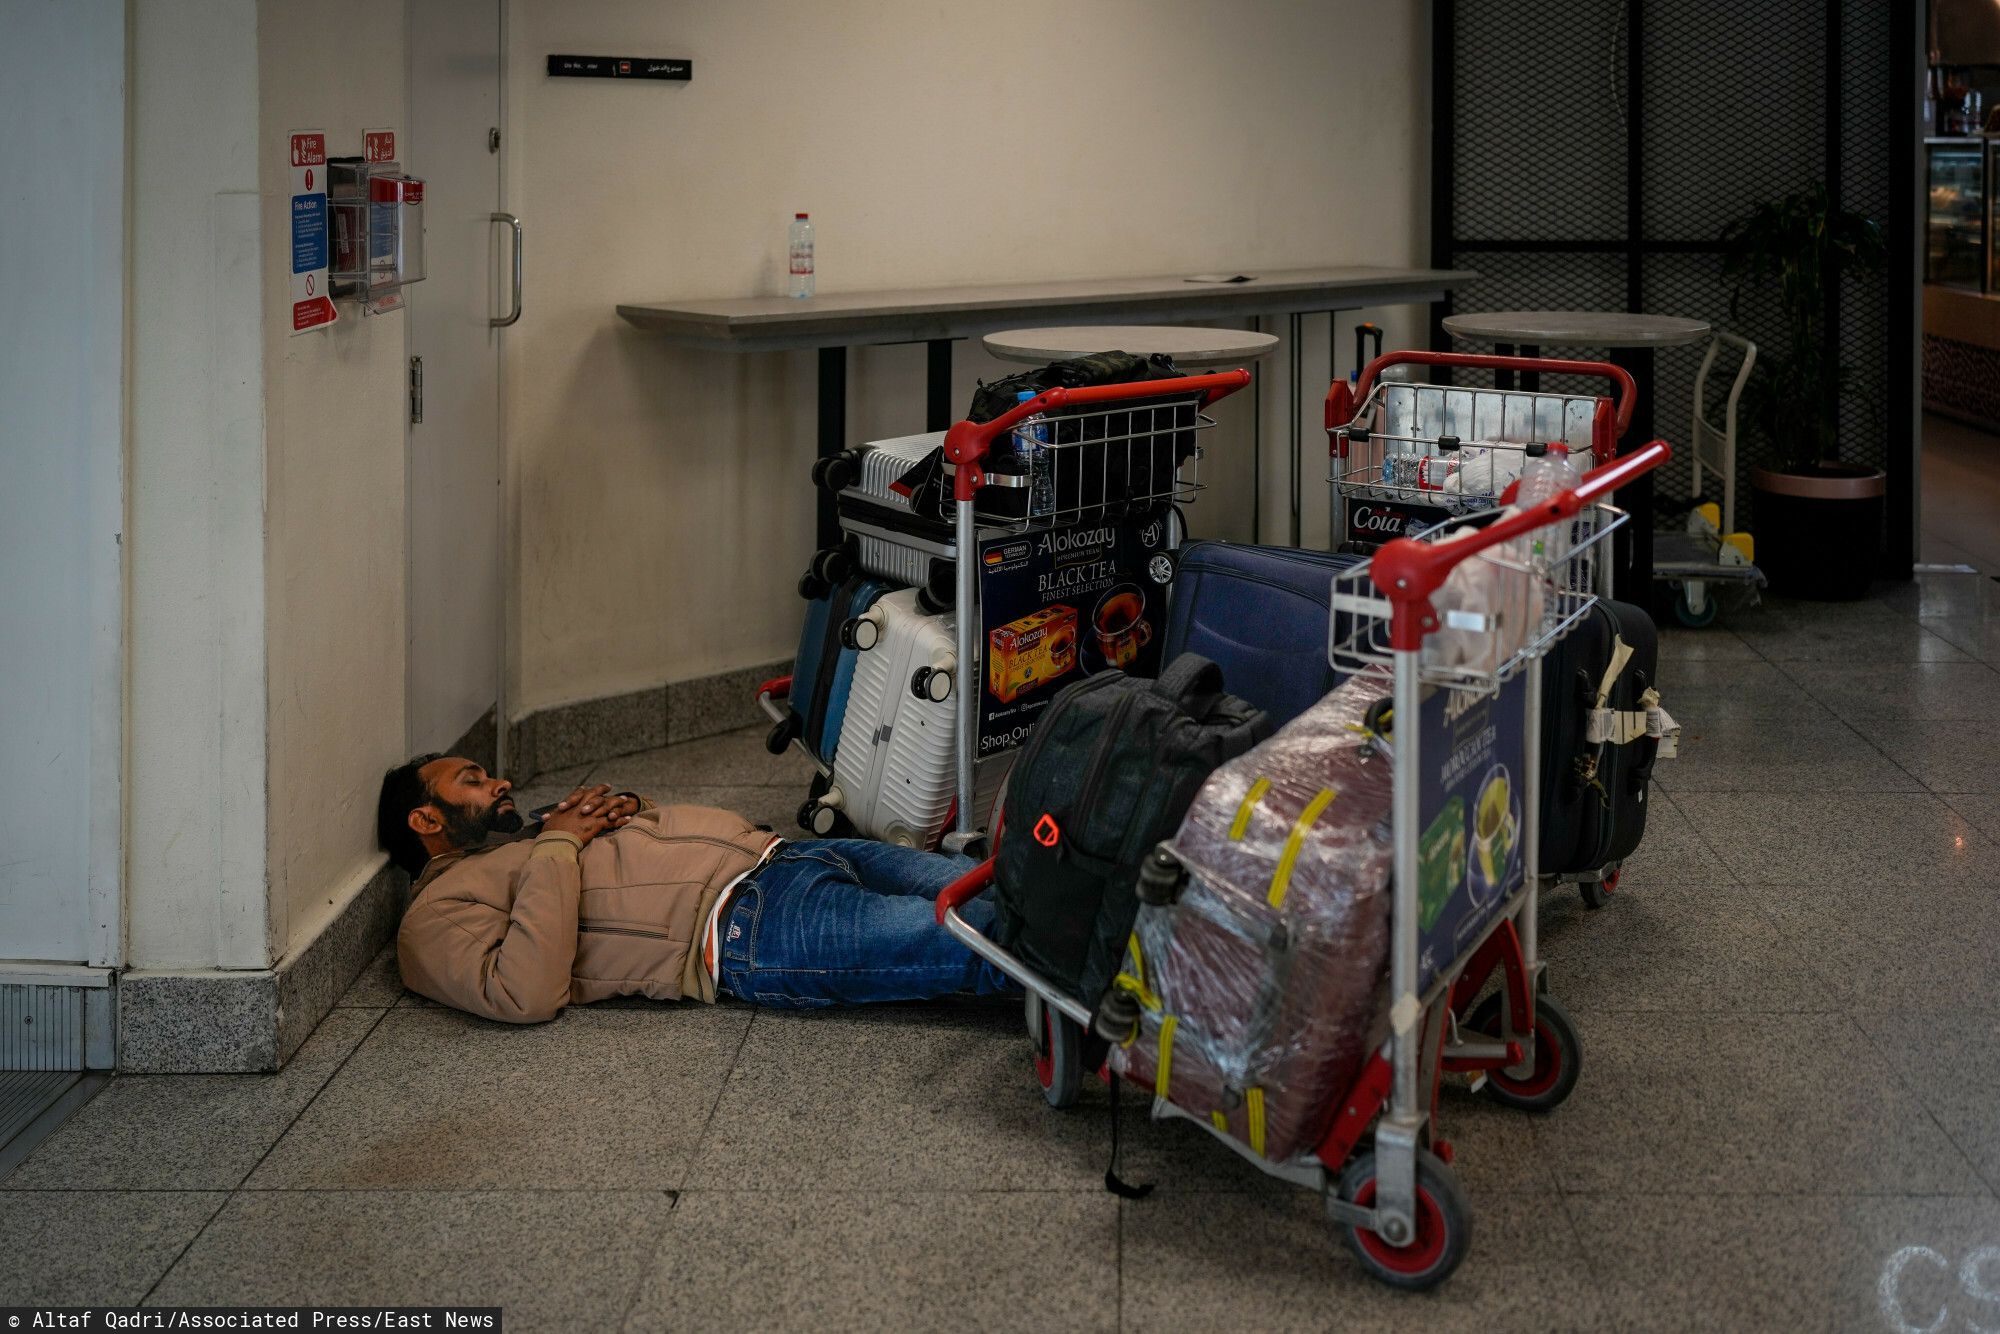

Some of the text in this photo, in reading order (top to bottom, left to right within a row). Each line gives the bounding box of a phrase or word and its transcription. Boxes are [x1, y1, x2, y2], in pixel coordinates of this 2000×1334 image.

[306, 137, 317, 149] Fire
[306, 152, 323, 163] Alarm
[294, 200, 318, 211] Fire Action
[1003, 544, 1027, 555] GERMAN
[1038, 527, 1116, 556] Alokozay
[1038, 559, 1116, 592] BLACK TEA
[1041, 577, 1115, 603] FINEST SELECTION
[1009, 627, 1049, 651] Alokozay
[981, 722, 1035, 750] Shop Onl
